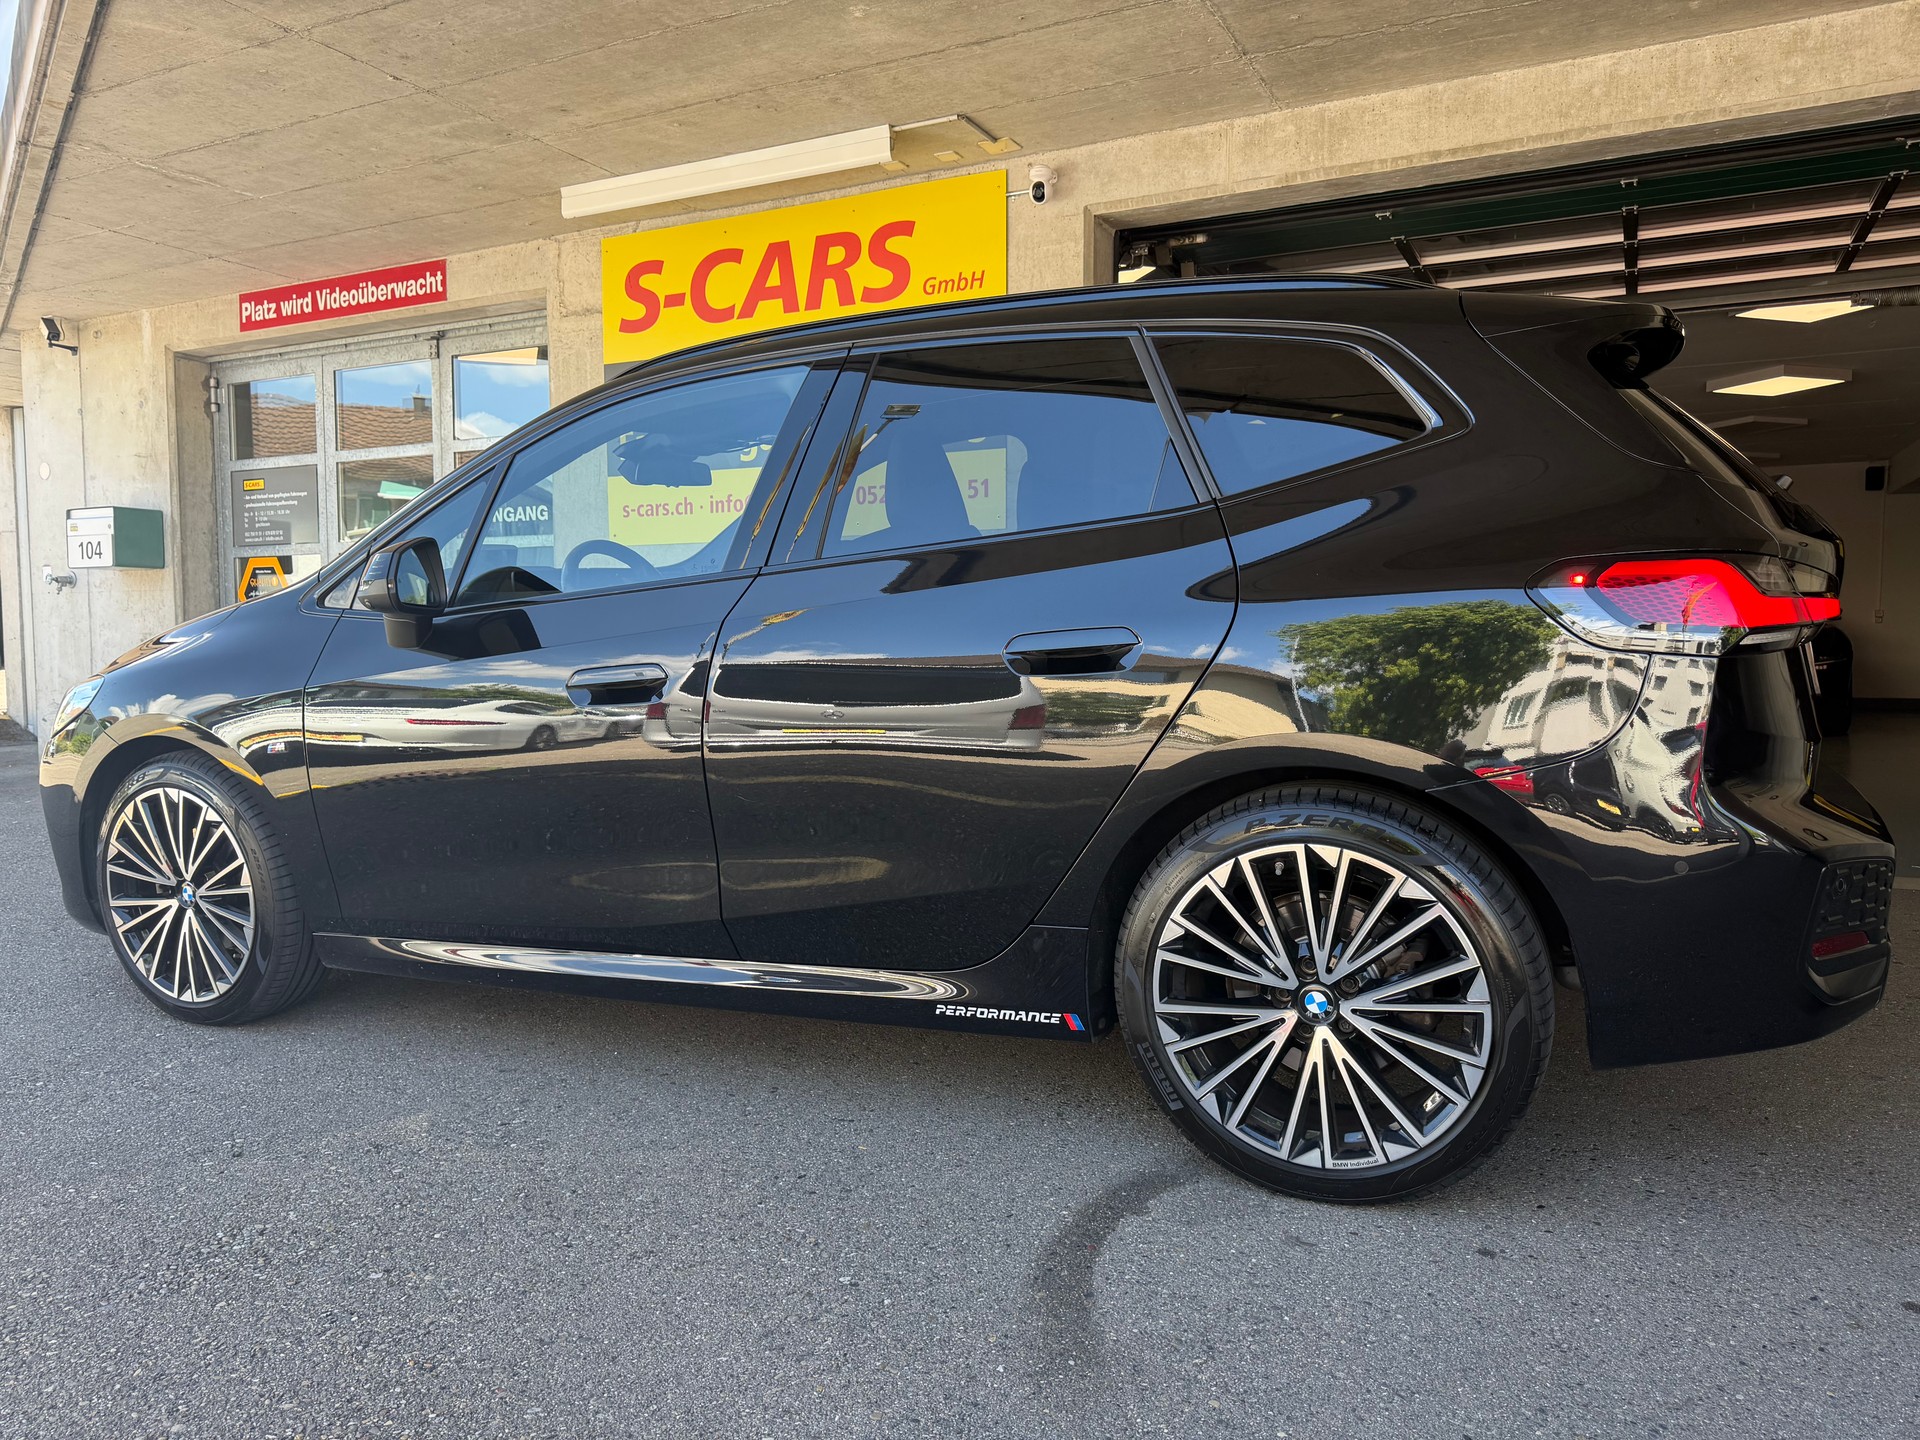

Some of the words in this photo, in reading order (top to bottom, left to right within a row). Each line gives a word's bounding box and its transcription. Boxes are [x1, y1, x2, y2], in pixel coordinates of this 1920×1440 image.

[618, 220, 915, 333] S-CARS
[922, 270, 985, 296] GmbH
[241, 300, 277, 324] Platz
[280, 292, 312, 317] wird
[315, 271, 443, 311] Videoüberwacht
[622, 497, 694, 518] s-cars.ch
[967, 478, 989, 499] 51
[492, 505, 549, 522] NGANG
[78, 540, 103, 560] 104
[1275, 813, 1387, 840] ZERO
[935, 1004, 1062, 1024] PERFORMANCE
[1136, 1041, 1184, 1111] PIRELLI
[1349, 1157, 1380, 1168] Individual
